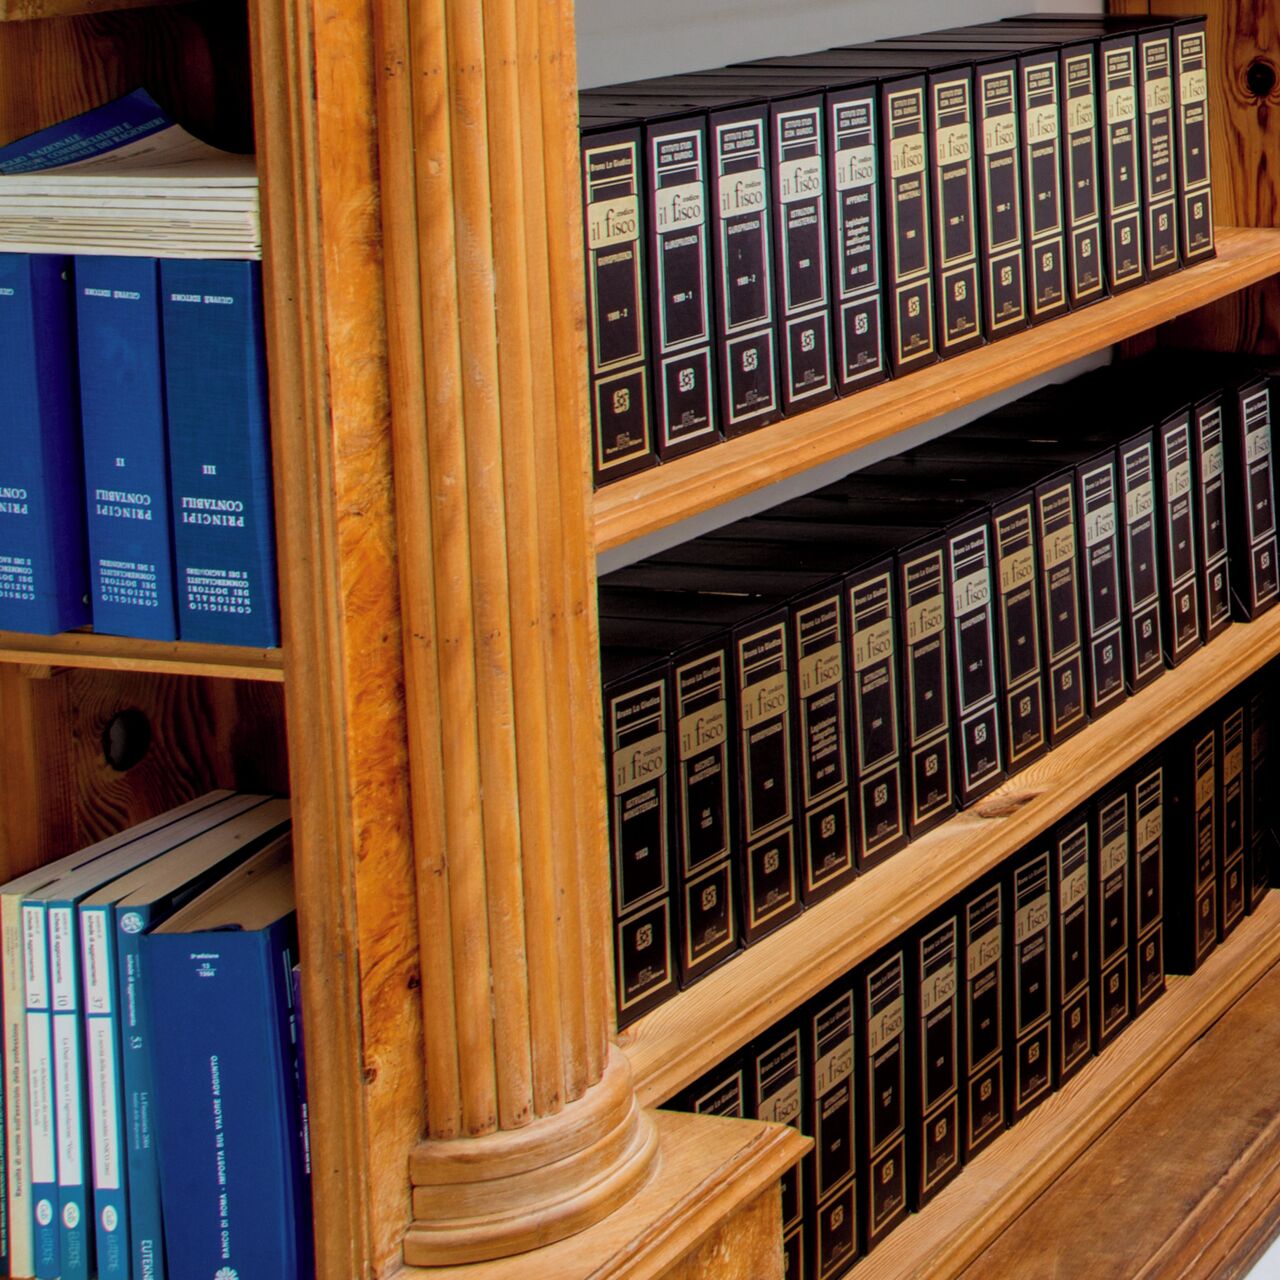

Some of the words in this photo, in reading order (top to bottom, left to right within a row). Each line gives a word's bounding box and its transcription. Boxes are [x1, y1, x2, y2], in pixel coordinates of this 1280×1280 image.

[782, 178, 791, 196] il
[794, 166, 820, 193] fisco
[837, 167, 846, 184] il
[849, 155, 874, 182] fisco
[721, 193, 731, 212] il
[734, 180, 763, 209] fisco
[658, 207, 668, 226] il
[671, 194, 701, 223] fisco
[591, 222, 601, 241] il
[605, 208, 636, 238] fisco
[115, 458, 125, 467] II
[202, 464, 217, 475] III
[95, 489, 151, 505] CONTABILI
[181, 497, 244, 512] CONTABILI
[96, 504, 152, 520] PRINCIPI
[182, 512, 245, 527] PRINCIPI
[101, 577, 137, 588] DOTTORI
[101, 585, 158, 598] NAZIONALE
[187, 576, 249, 588] COMMERCIALISTI
[187, 585, 228, 596] DOTTORI
[233, 587, 249, 596] DEI
[101, 594, 158, 607] CONSIGLIO
[188, 594, 251, 605] NAZIONALE
[189, 602, 252, 614] CONSIGLIO
[955, 595, 963, 611] il
[965, 581, 988, 606] fisco
[909, 622, 917, 639] il
[919, 608, 943, 634] fisco
[856, 647, 864, 664] il
[867, 632, 891, 660] fisco
[802, 673, 810, 692] il
[813, 658, 840, 686] fisco
[617, 708, 633, 721] Bruno
[633, 705, 640, 713] Lo
[640, 696, 660, 710] Giudice
[744, 703, 753, 722] il
[757, 687, 785, 716] fisco
[683, 733, 691, 753] il
[695, 717, 724, 747] fisco
[617, 768, 626, 787] il
[631, 750, 663, 781] fisco
[30, 993, 41, 1005] 15
[57, 995, 69, 1007] 10
[93, 998, 104, 1010] 37
[126, 954, 134, 975] schede
[130, 1035, 143, 1049] 53
[210, 1055, 221, 1096] AGGIUNTO
[818, 1073, 825, 1091] il
[828, 1055, 852, 1084] fisco
[213, 1098, 223, 1130] VALORE
[773, 1097, 799, 1124] fisco
[215, 1132, 224, 1148] SUL
[216, 1150, 226, 1185] IMPOSTA
[219, 1193, 228, 1217] ROMA
[220, 1219, 229, 1229] DI
[221, 1230, 230, 1259] BANCO
